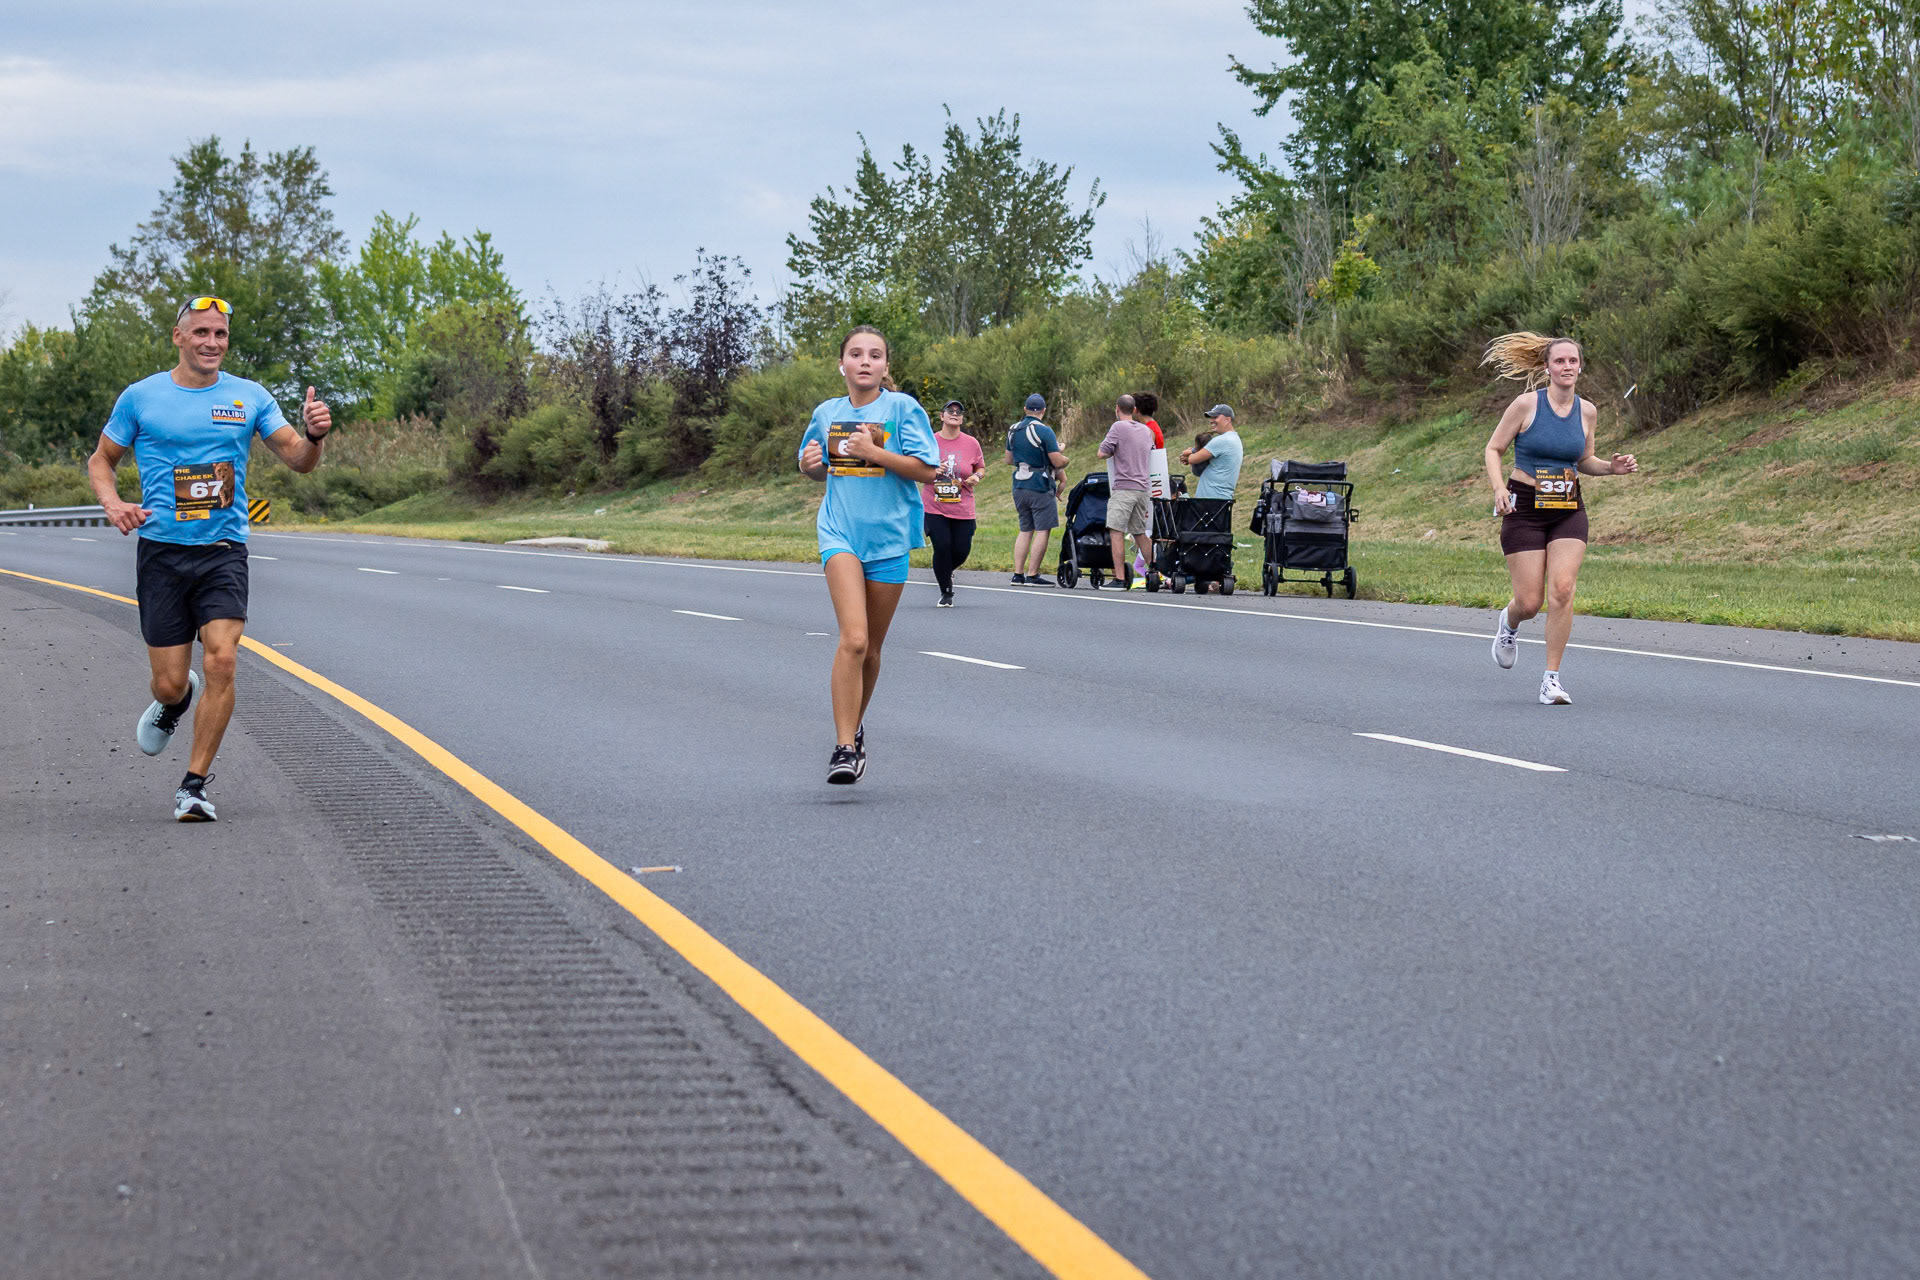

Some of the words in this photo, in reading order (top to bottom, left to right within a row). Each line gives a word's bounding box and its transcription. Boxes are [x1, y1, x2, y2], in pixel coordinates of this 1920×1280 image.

[213, 410, 245, 418] MALIBU
[190, 480, 224, 498] 67
[937, 485, 959, 494] 199
[1540, 480, 1574, 493] 337
